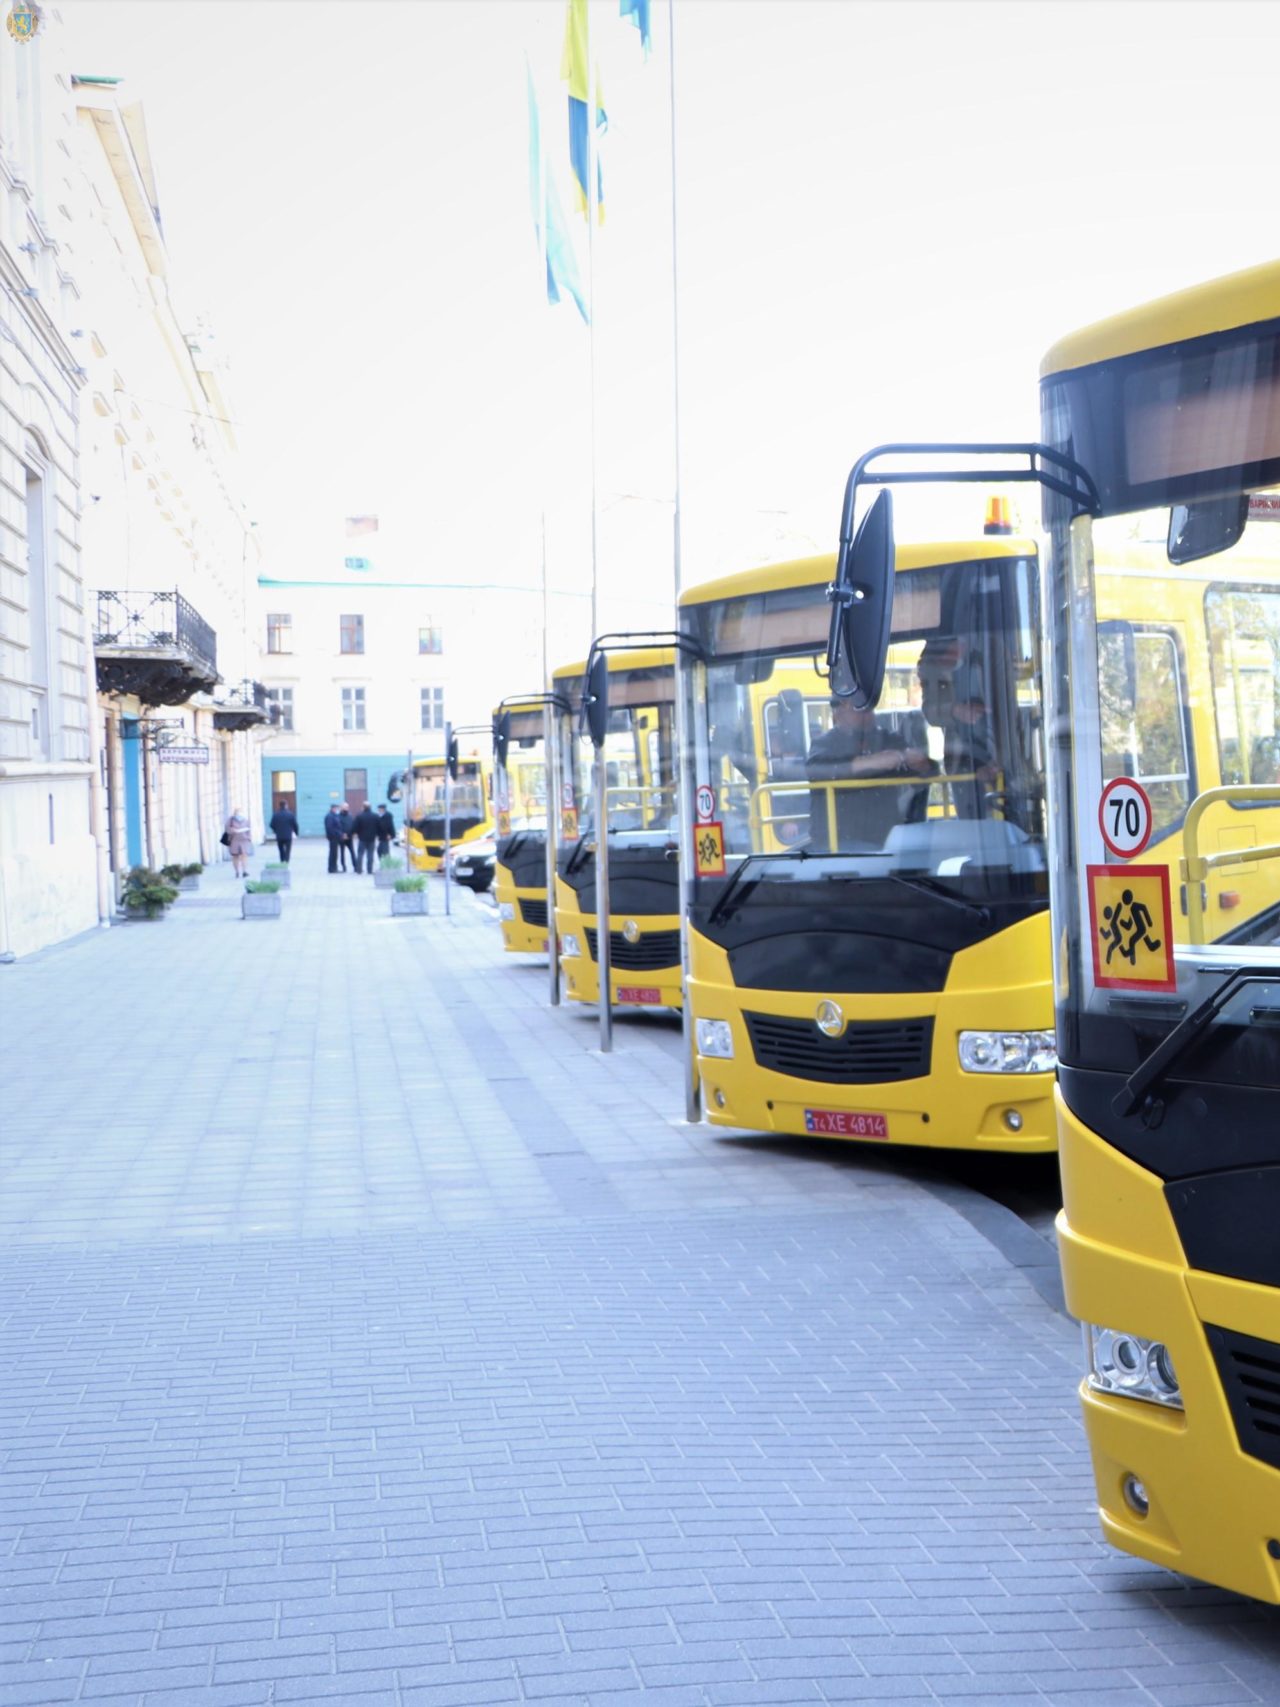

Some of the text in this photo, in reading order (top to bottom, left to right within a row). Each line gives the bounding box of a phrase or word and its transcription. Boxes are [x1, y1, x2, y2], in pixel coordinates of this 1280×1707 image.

[699, 794, 711, 810] 70
[1109, 798, 1140, 837] 70
[850, 1115, 884, 1135] 4814
